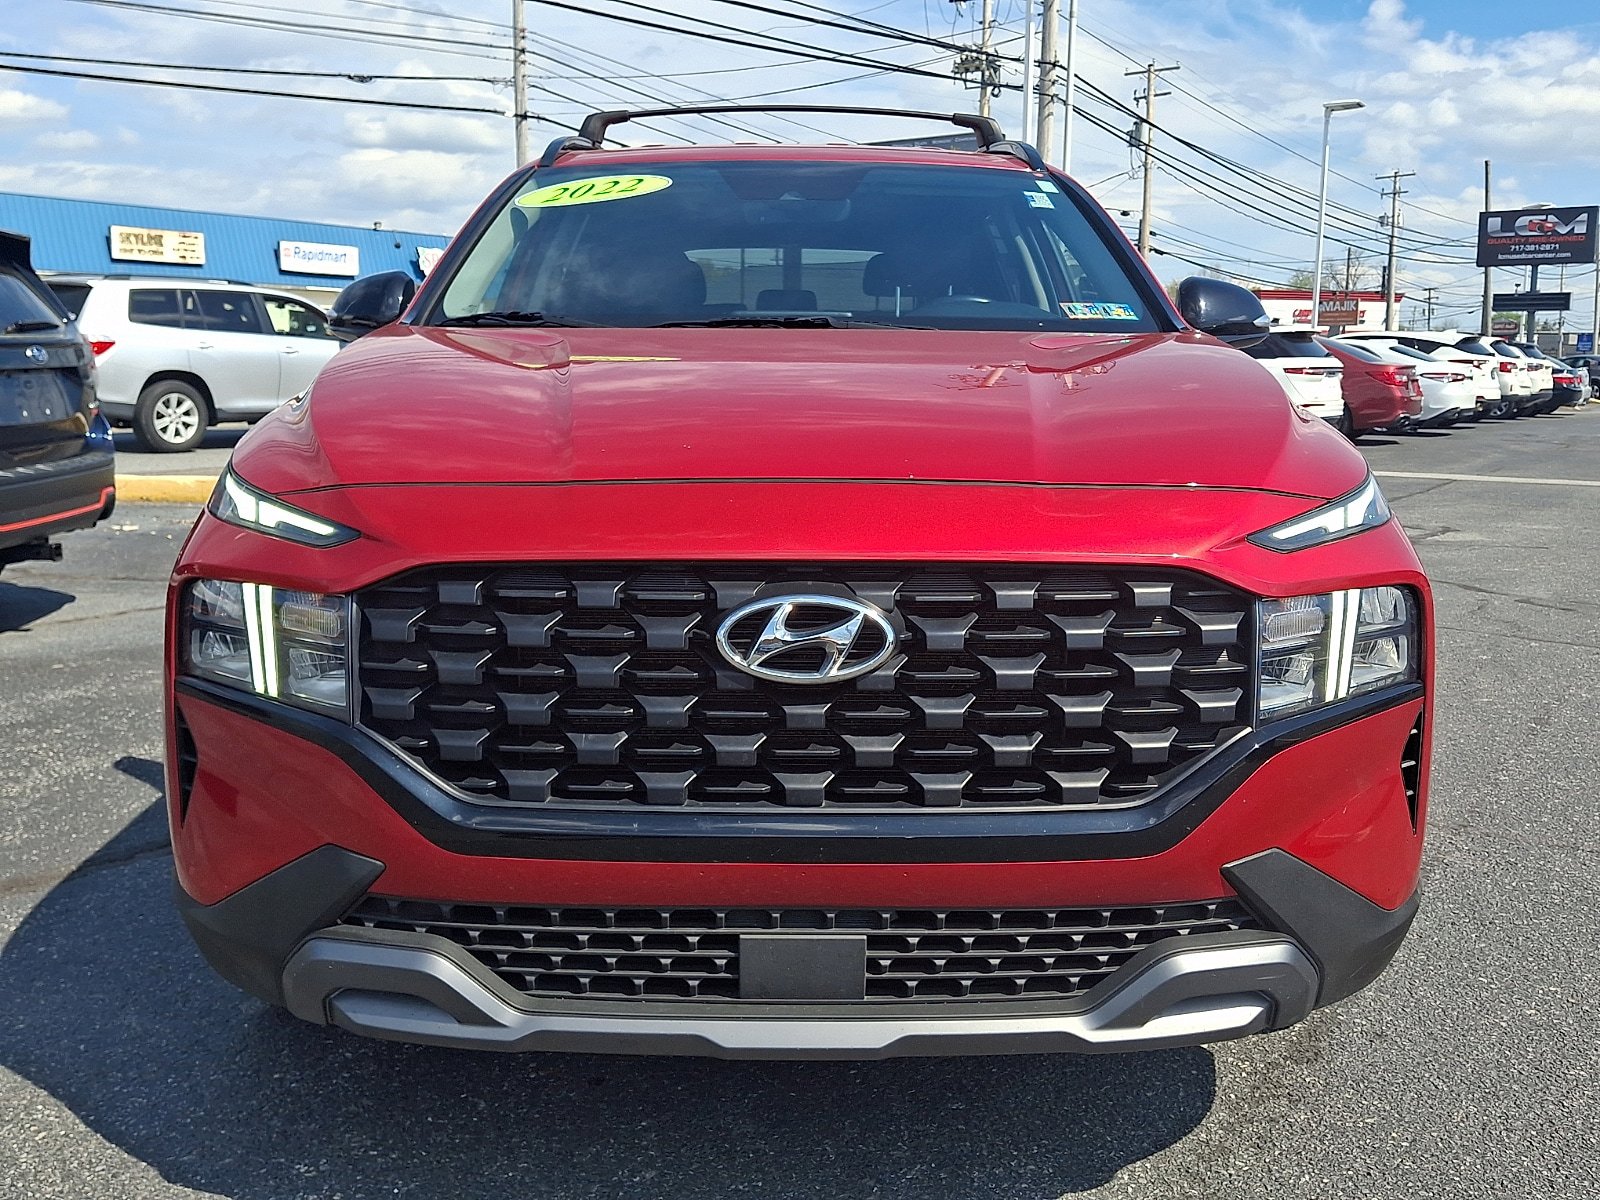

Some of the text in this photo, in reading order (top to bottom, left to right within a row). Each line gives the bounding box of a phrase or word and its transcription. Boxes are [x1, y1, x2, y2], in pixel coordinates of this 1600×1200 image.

[541, 178, 644, 204] 2022
[293, 246, 347, 263] Rapidmart
[1322, 300, 1357, 312] MAJIK
